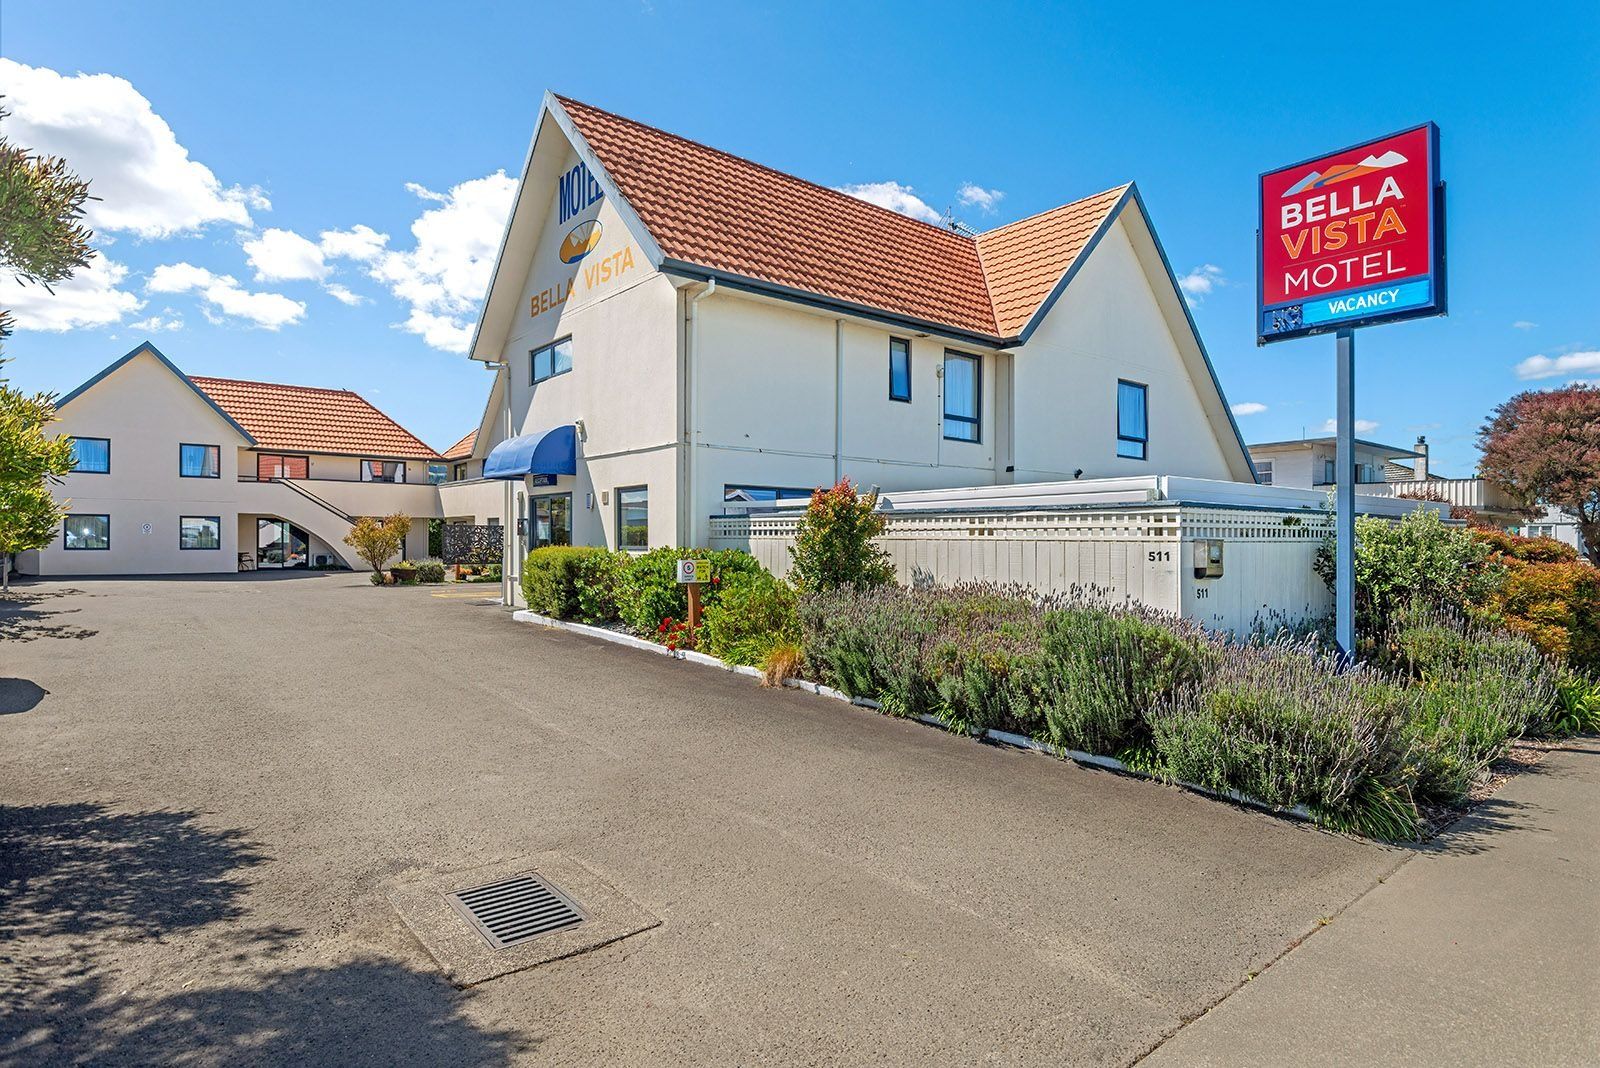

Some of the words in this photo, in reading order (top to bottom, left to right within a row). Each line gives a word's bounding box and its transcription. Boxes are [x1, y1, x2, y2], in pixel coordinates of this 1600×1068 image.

[1281, 176, 1404, 229] BELLA
[1281, 207, 1407, 260] VISTA
[531, 277, 575, 318] BELLA
[584, 246, 634, 290] VISTA
[1285, 250, 1406, 294] MOTEL
[1328, 289, 1399, 313] VACANCY
[1148, 551, 1170, 562] 511
[1196, 588, 1208, 599] 511
